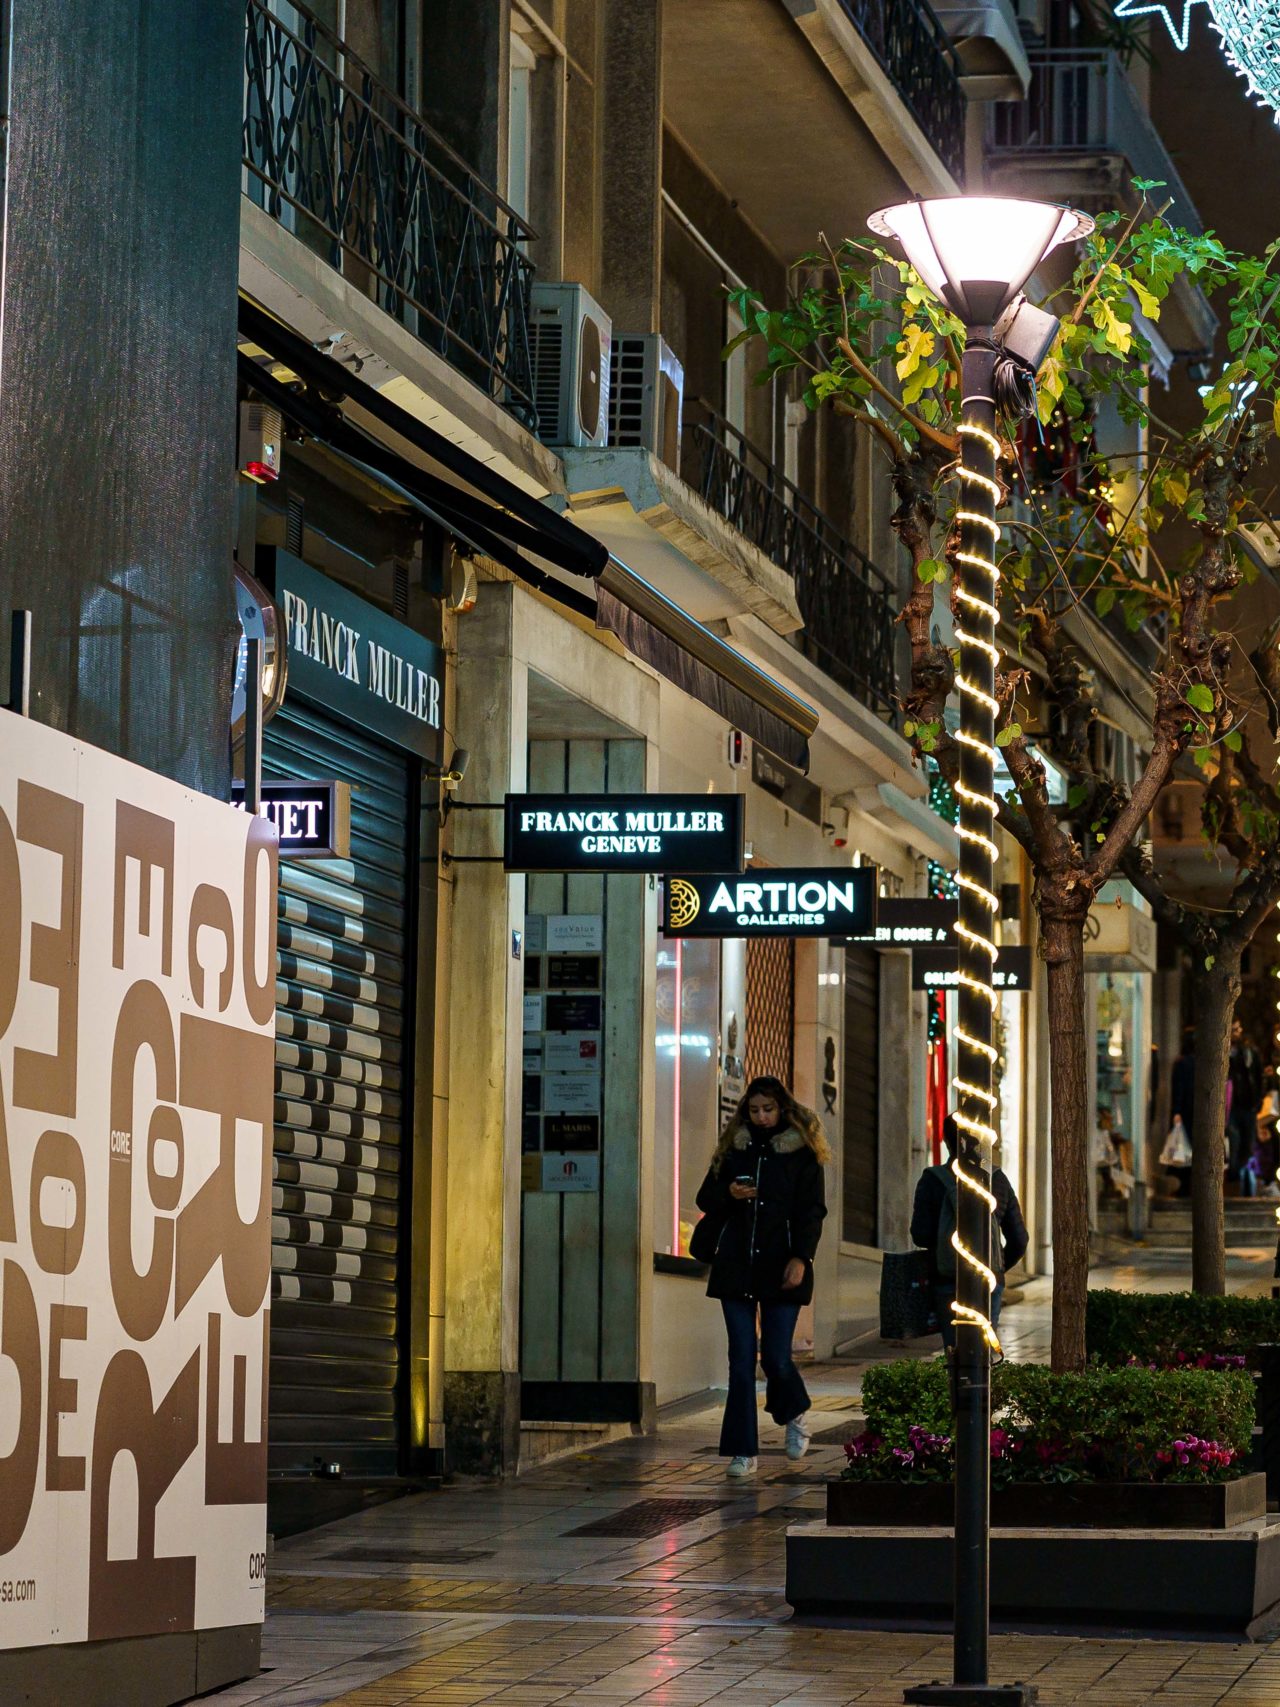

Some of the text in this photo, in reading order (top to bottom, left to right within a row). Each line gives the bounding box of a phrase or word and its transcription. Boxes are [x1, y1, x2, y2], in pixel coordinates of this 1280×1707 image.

[283, 589, 440, 729] FRANCK MULLER
[520, 811, 724, 832] FRANCK MULLER
[581, 835, 661, 853] GENEVE
[708, 881, 855, 913] ARTION
[736, 913, 825, 927] GALLERIES
[111, 1130, 131, 1154] CORE
